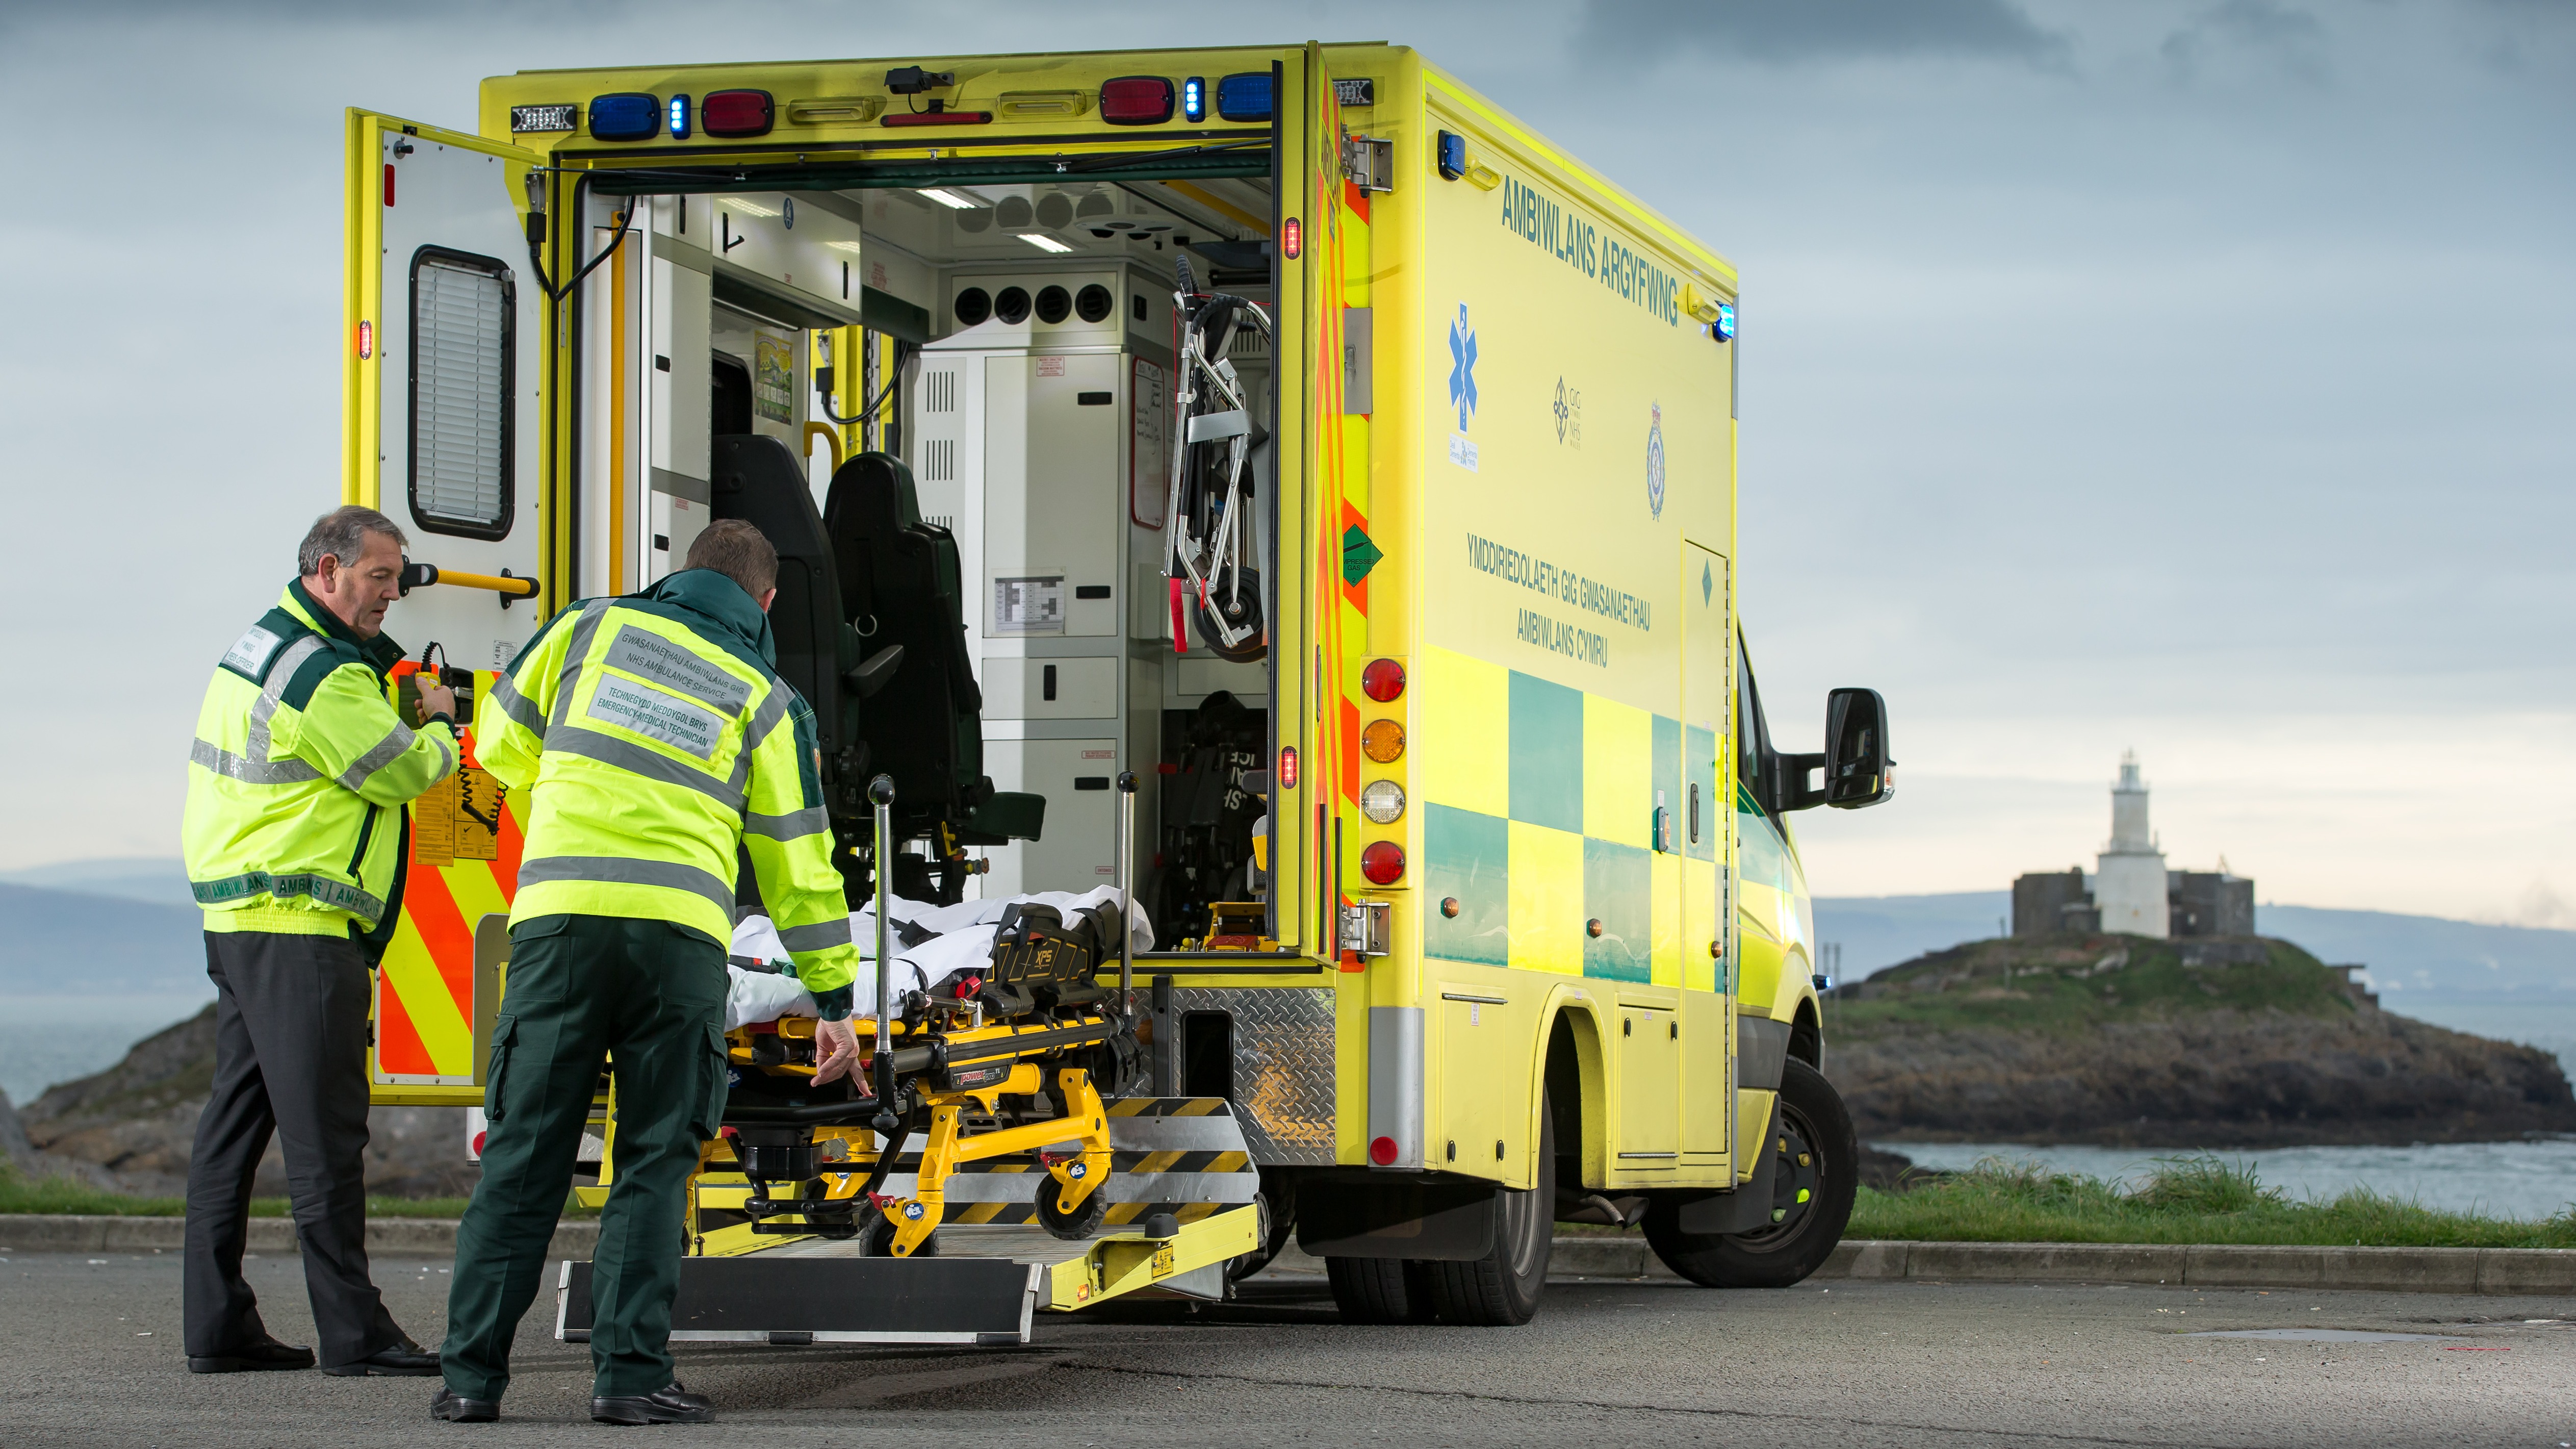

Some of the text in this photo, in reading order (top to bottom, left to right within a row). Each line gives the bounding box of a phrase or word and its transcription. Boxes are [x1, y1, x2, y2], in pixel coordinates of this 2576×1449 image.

[1502, 174, 1678, 328] AMBIWLANS ARGYFWNG
[1569, 388, 1581, 409] GIG
[1569, 419, 1581, 441] NHS
[1466, 532, 1651, 632] YMDDIRIEDOLAETH GIG GWASANAETHAU
[1517, 607, 1608, 669] AMBIWLANS CYMRU
[622, 633, 744, 694] GWASANAETHAU AMBIWLANS GIG
[626, 652, 727, 699] NHS AMBULANCE SERVICE
[597, 697, 709, 747] EMERGENCY MEDICAL TECHNICIAN
[608, 687, 708, 732] TECHNEGYDD MEDDYGOL BRYS
[212, 875, 271, 899] AMBIWLANS
[1035, 950, 1053, 965] XPS
[960, 1070, 985, 1085] power
